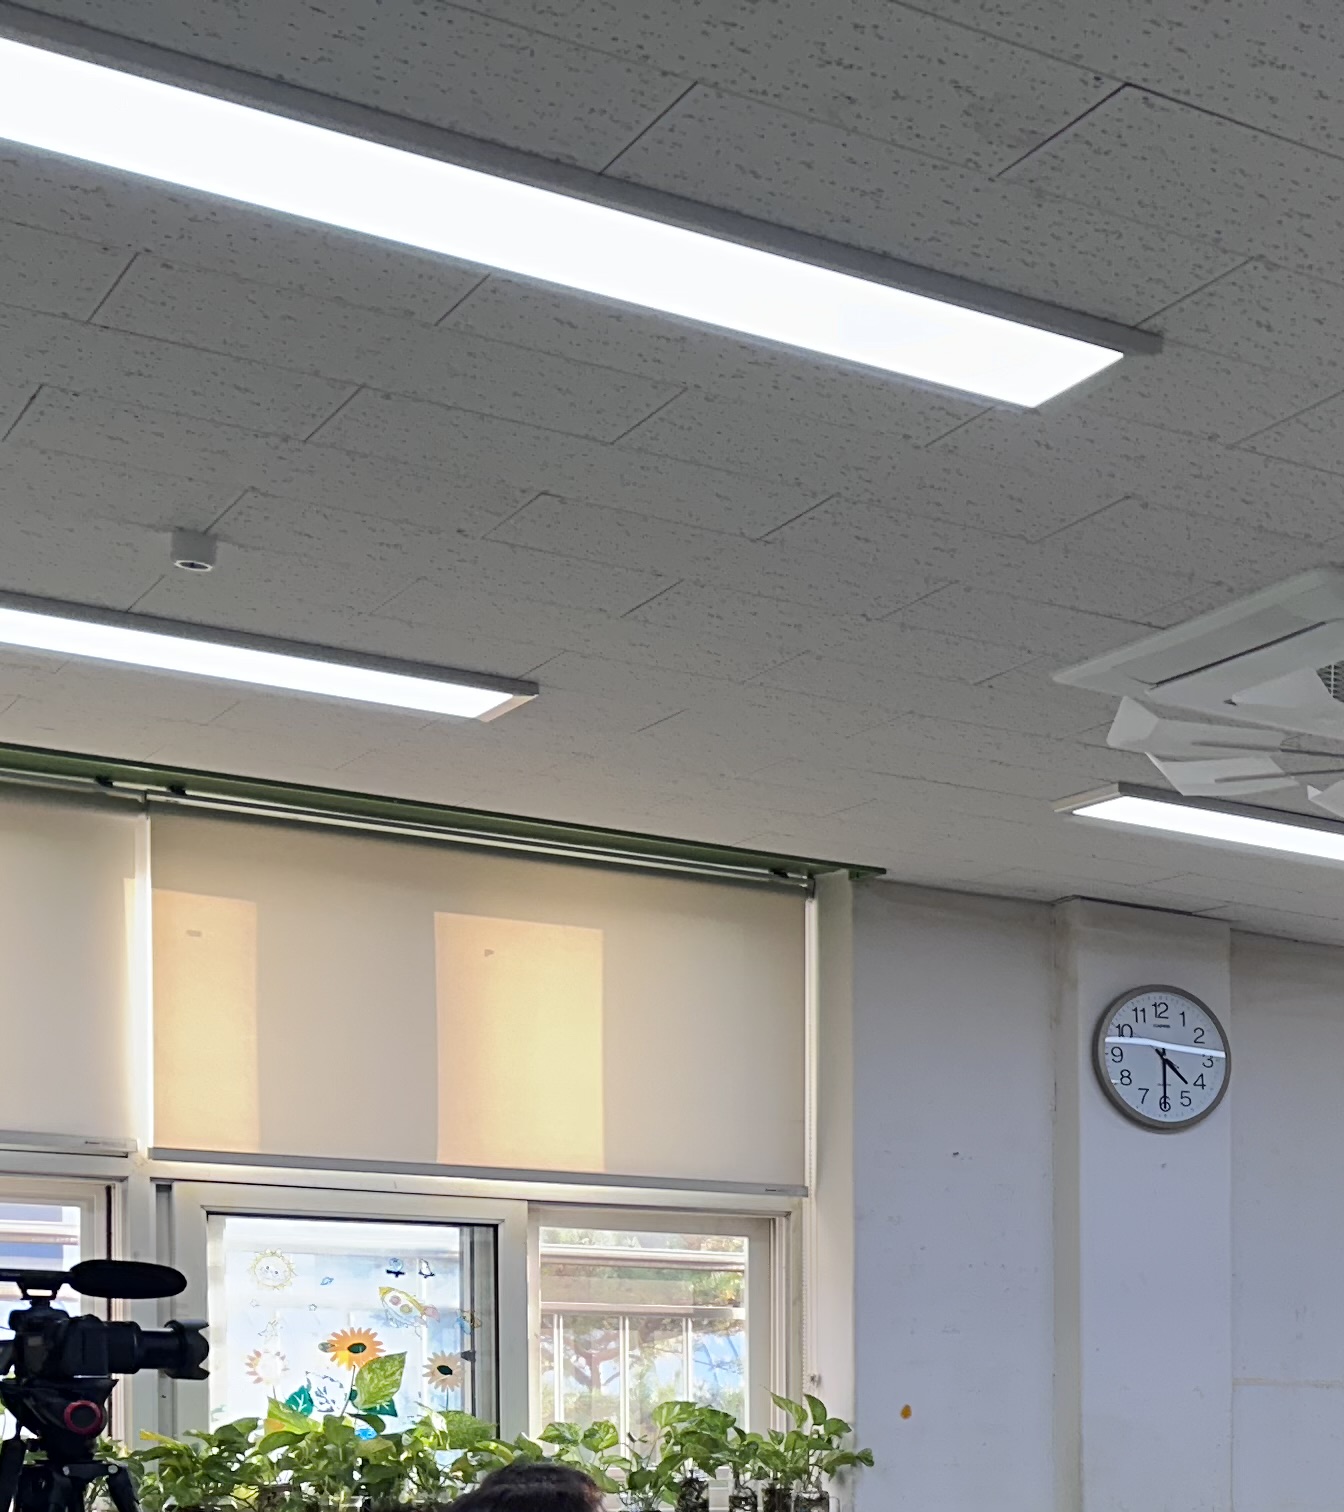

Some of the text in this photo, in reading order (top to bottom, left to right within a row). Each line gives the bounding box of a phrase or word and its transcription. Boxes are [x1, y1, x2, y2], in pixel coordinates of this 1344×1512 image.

[1132, 1007, 1146, 1024] 11
[1151, 1001, 1169, 1020] 12
[1179, 1011, 1186, 1027] 1
[1115, 1024, 1134, 1038] 10
[1193, 1027, 1206, 1044] 2
[1111, 1046, 1124, 1063] 9
[1202, 1054, 1214, 1069] 3
[1120, 1069, 1132, 1086] 8
[1193, 1073, 1206, 1090] 4
[1138, 1087, 1150, 1104] 7
[1159, 1095, 1171, 1112] 6
[1180, 1090, 1192, 1107] 5
